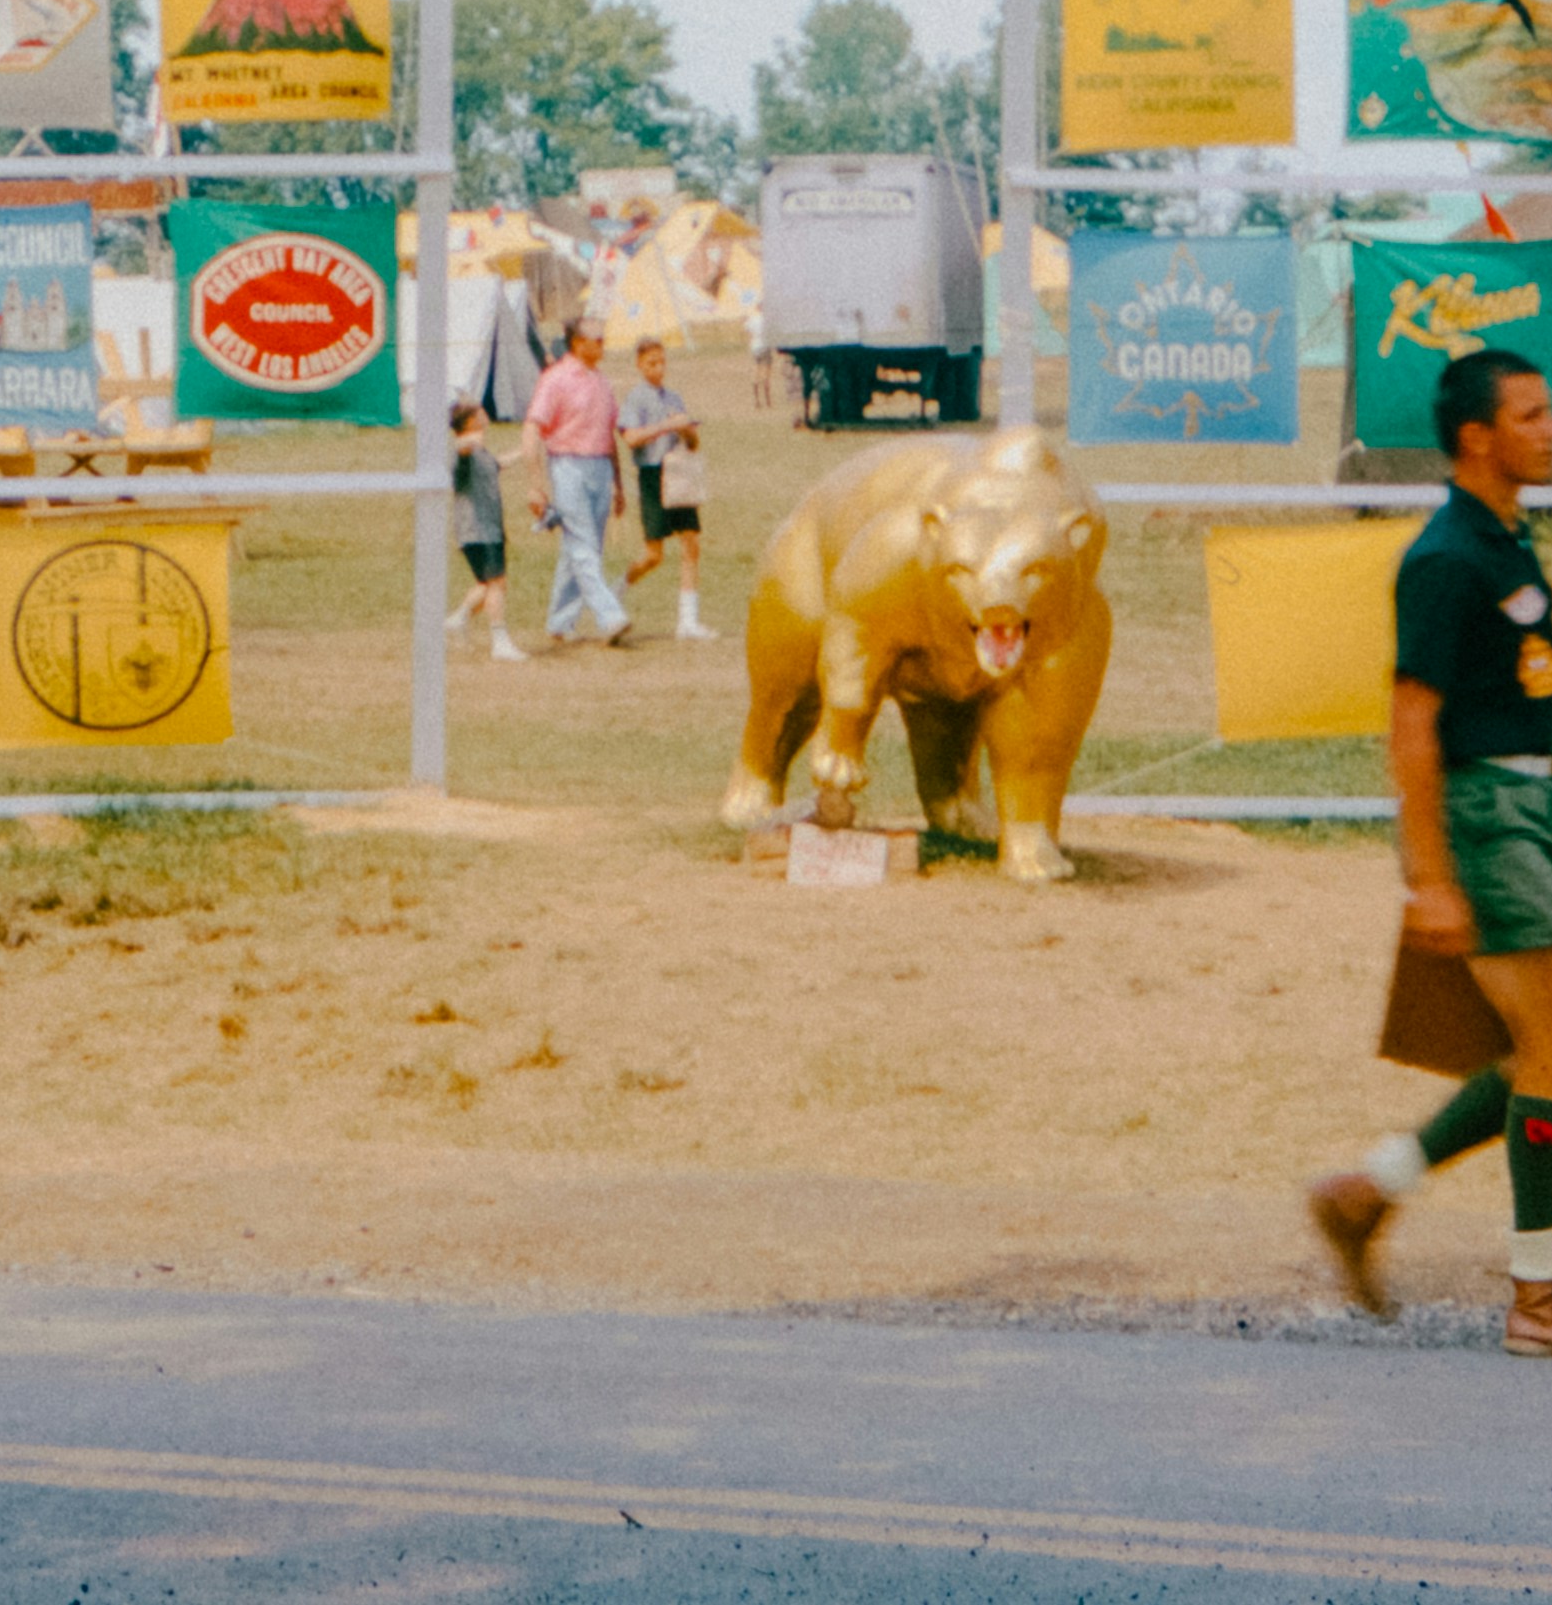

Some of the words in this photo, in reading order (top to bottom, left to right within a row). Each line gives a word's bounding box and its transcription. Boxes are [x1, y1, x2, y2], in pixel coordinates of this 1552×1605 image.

[204, 246, 286, 305] CRESCENT
[292, 247, 332, 277] BAY
[327, 263, 372, 307] AREA
[249, 302, 334, 323] COUNCIL
[1118, 279, 1258, 334] ONTARIO
[210, 322, 258, 367] WEST
[259, 352, 294, 380] LOS
[299, 325, 370, 380] ANGELES
[1117, 342, 1254, 382] CANADA
